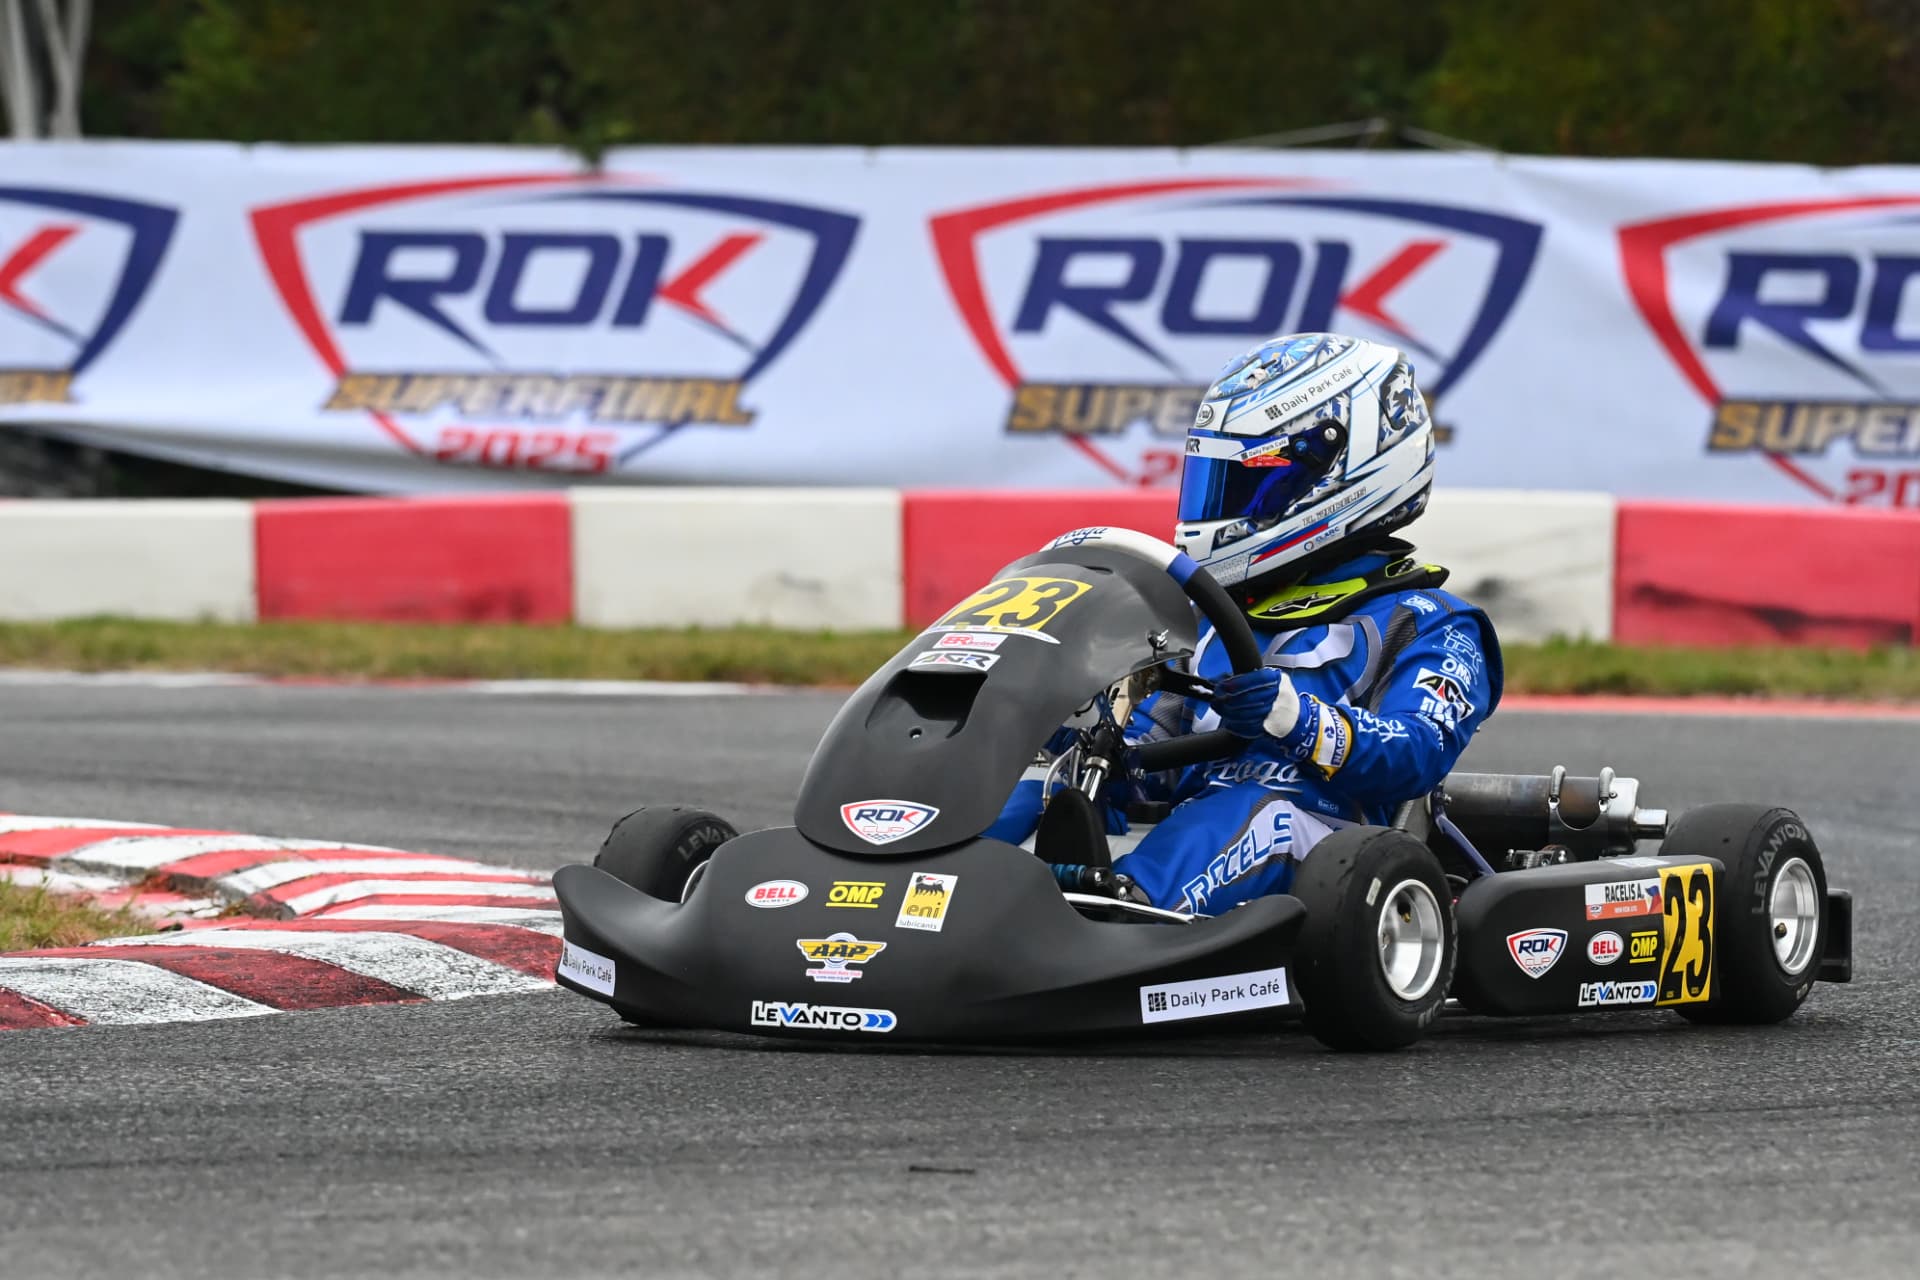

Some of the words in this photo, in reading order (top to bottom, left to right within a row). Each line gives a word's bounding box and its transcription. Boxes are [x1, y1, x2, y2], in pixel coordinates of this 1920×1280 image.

[338, 229, 765, 365] ROK
[1012, 238, 1450, 375] ROK
[322, 372, 757, 425] SUPERFINAL
[1281, 392, 1310, 412] Daily
[1308, 377, 1333, 396] Park
[1331, 366, 1352, 382] Café
[436, 427, 618, 473] 2025
[940, 579, 1080, 628] 23
[855, 809, 919, 826] ROK
[754, 887, 797, 899] BELL
[829, 886, 883, 903] OMP
[1605, 884, 1636, 903] RACELIS
[906, 902, 941, 919] eni
[1659, 868, 1711, 999] 23
[811, 944, 868, 957] AAP
[1518, 937, 1555, 954] ROK
[1592, 939, 1618, 955] BELL
[1630, 936, 1657, 956] OMP
[582, 960, 596, 976] Park
[597, 963, 612, 982] Café
[1171, 991, 1207, 1007] Daily
[1211, 988, 1245, 1002] Park
[1250, 979, 1280, 997] Café
[1581, 985, 1641, 1001] LEVANTO
[754, 1006, 861, 1026] LEVANTO
